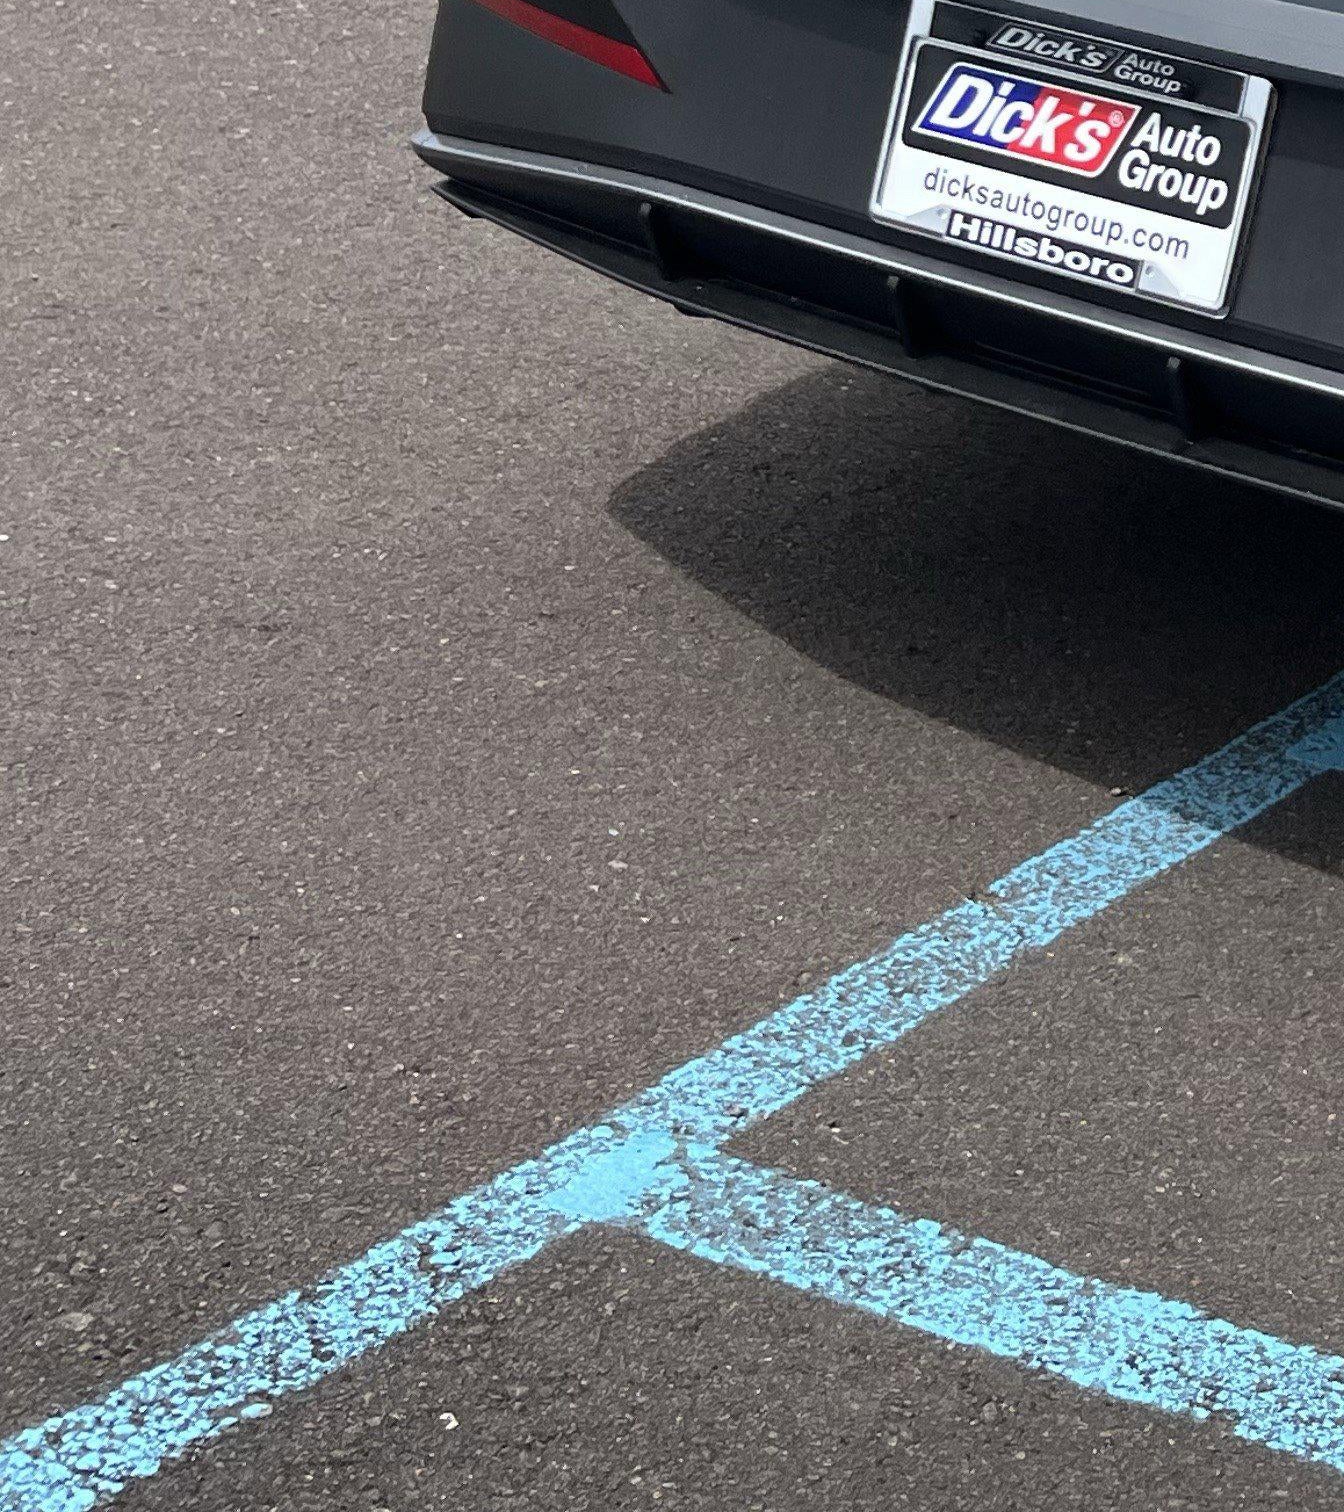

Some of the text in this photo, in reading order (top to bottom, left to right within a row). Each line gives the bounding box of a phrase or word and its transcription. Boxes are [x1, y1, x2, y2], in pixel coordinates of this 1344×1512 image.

[996, 27, 1107, 68] Dick's
[1122, 52, 1176, 76] Auto
[1113, 65, 1181, 94] Group
[928, 73, 1111, 163] Dick's
[1129, 112, 1221, 166] Auto
[1118, 148, 1229, 215] Group
[923, 167, 1190, 260] dicksautogroup.com
[949, 212, 1134, 284] Hillsboro
